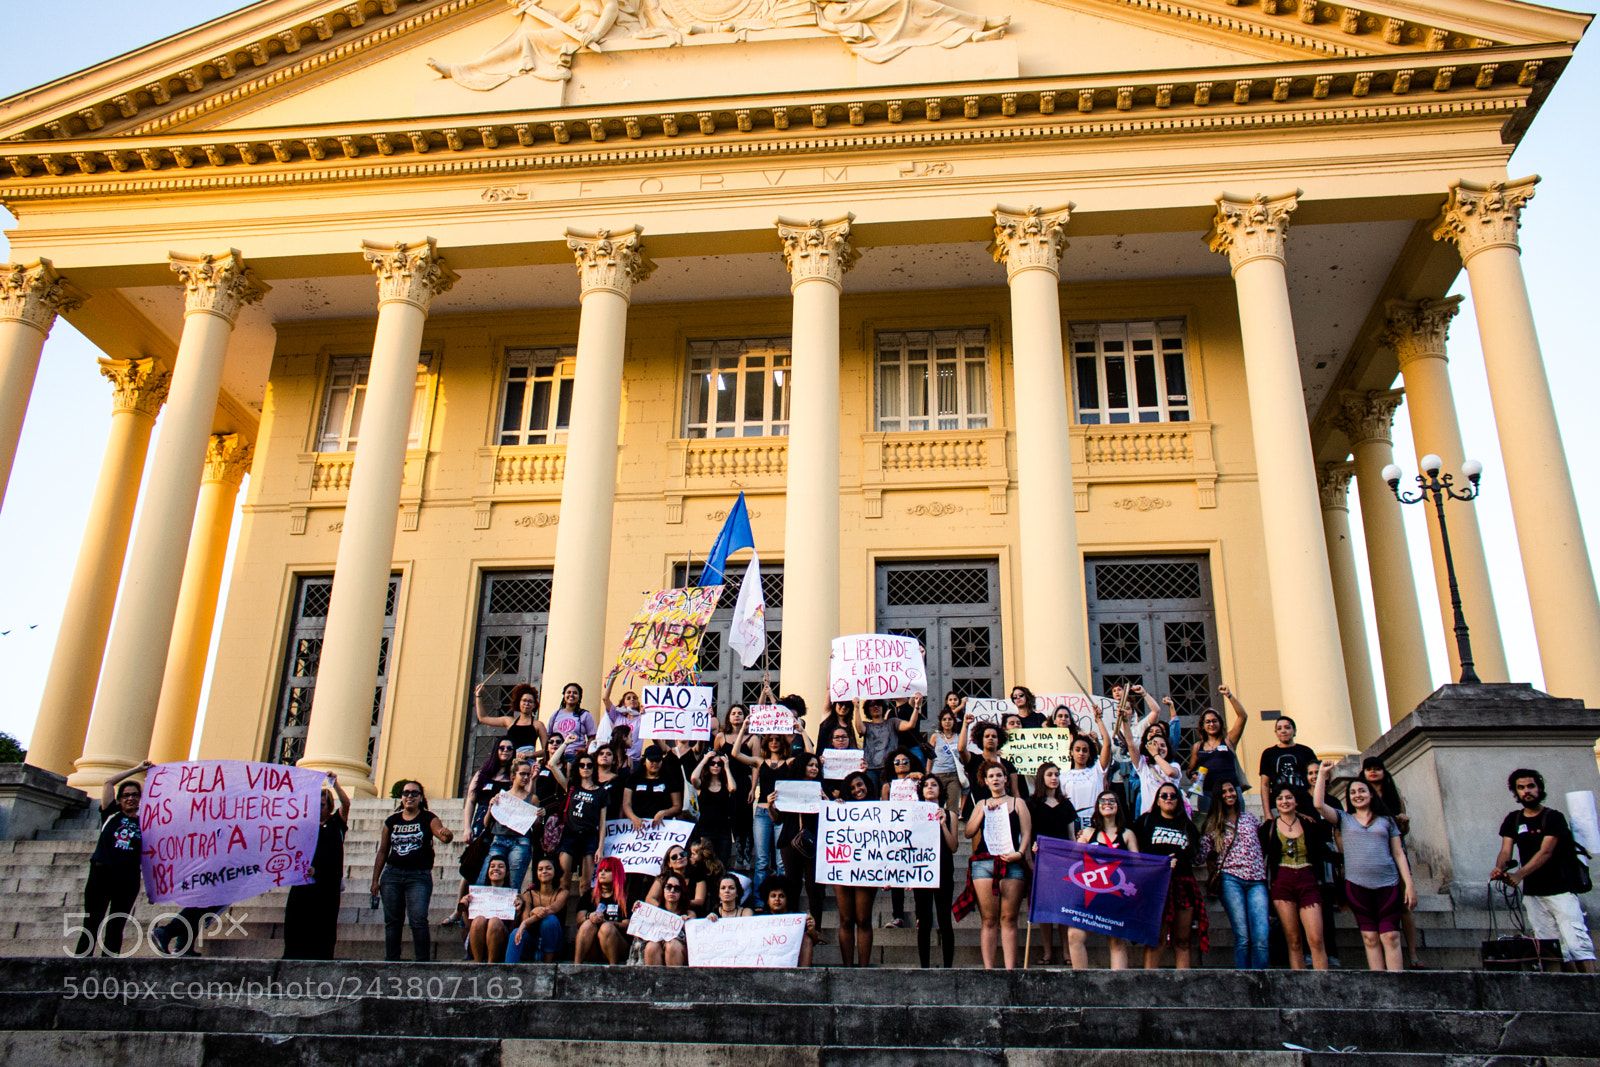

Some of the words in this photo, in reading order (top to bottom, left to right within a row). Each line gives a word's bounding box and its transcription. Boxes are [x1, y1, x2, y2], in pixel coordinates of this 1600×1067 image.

[842, 638, 912, 662] LIBERDADE
[851, 662, 857, 676] É
[864, 661, 880, 675] NÃO
[884, 661, 903, 672] TER
[857, 675, 898, 696] MEDO
[971, 700, 1008, 713] ATO
[1035, 695, 1091, 714] ONTRA
[653, 711, 686, 729] PEC
[692, 711, 709, 729] 181
[1033, 732, 1053, 741] VIDA
[1057, 733, 1069, 741] DAS
[1010, 741, 1059, 751] MULHERES!
[1037, 755, 1053, 763] PEC
[149, 767, 168, 798] É
[179, 764, 225, 793] PELA
[245, 764, 294, 793] VIDA
[141, 798, 173, 832] DAS
[189, 794, 309, 823] MULHERES!
[575, 800, 585, 813] 4
[826, 805, 881, 824] LUGAR
[891, 809, 907, 822] DE
[393, 823, 421, 833] TIGER
[635, 830, 687, 843] DIREITO
[157, 831, 217, 862] CONTRA
[258, 825, 299, 853] PEC
[610, 841, 659, 855] MENOS!
[826, 844, 852, 860] NÃO
[868, 848, 883, 861] NA
[152, 863, 175, 896] 181
[181, 864, 262, 892] #FORATEMER
[1081, 866, 1109, 888] PT
[1060, 906, 1094, 920] Secretaria
[1095, 914, 1125, 927] Nacional
[1072, 914, 1081, 923] de
[1082, 916, 1112, 931] Mulheres
[762, 933, 788, 947] NÃO
